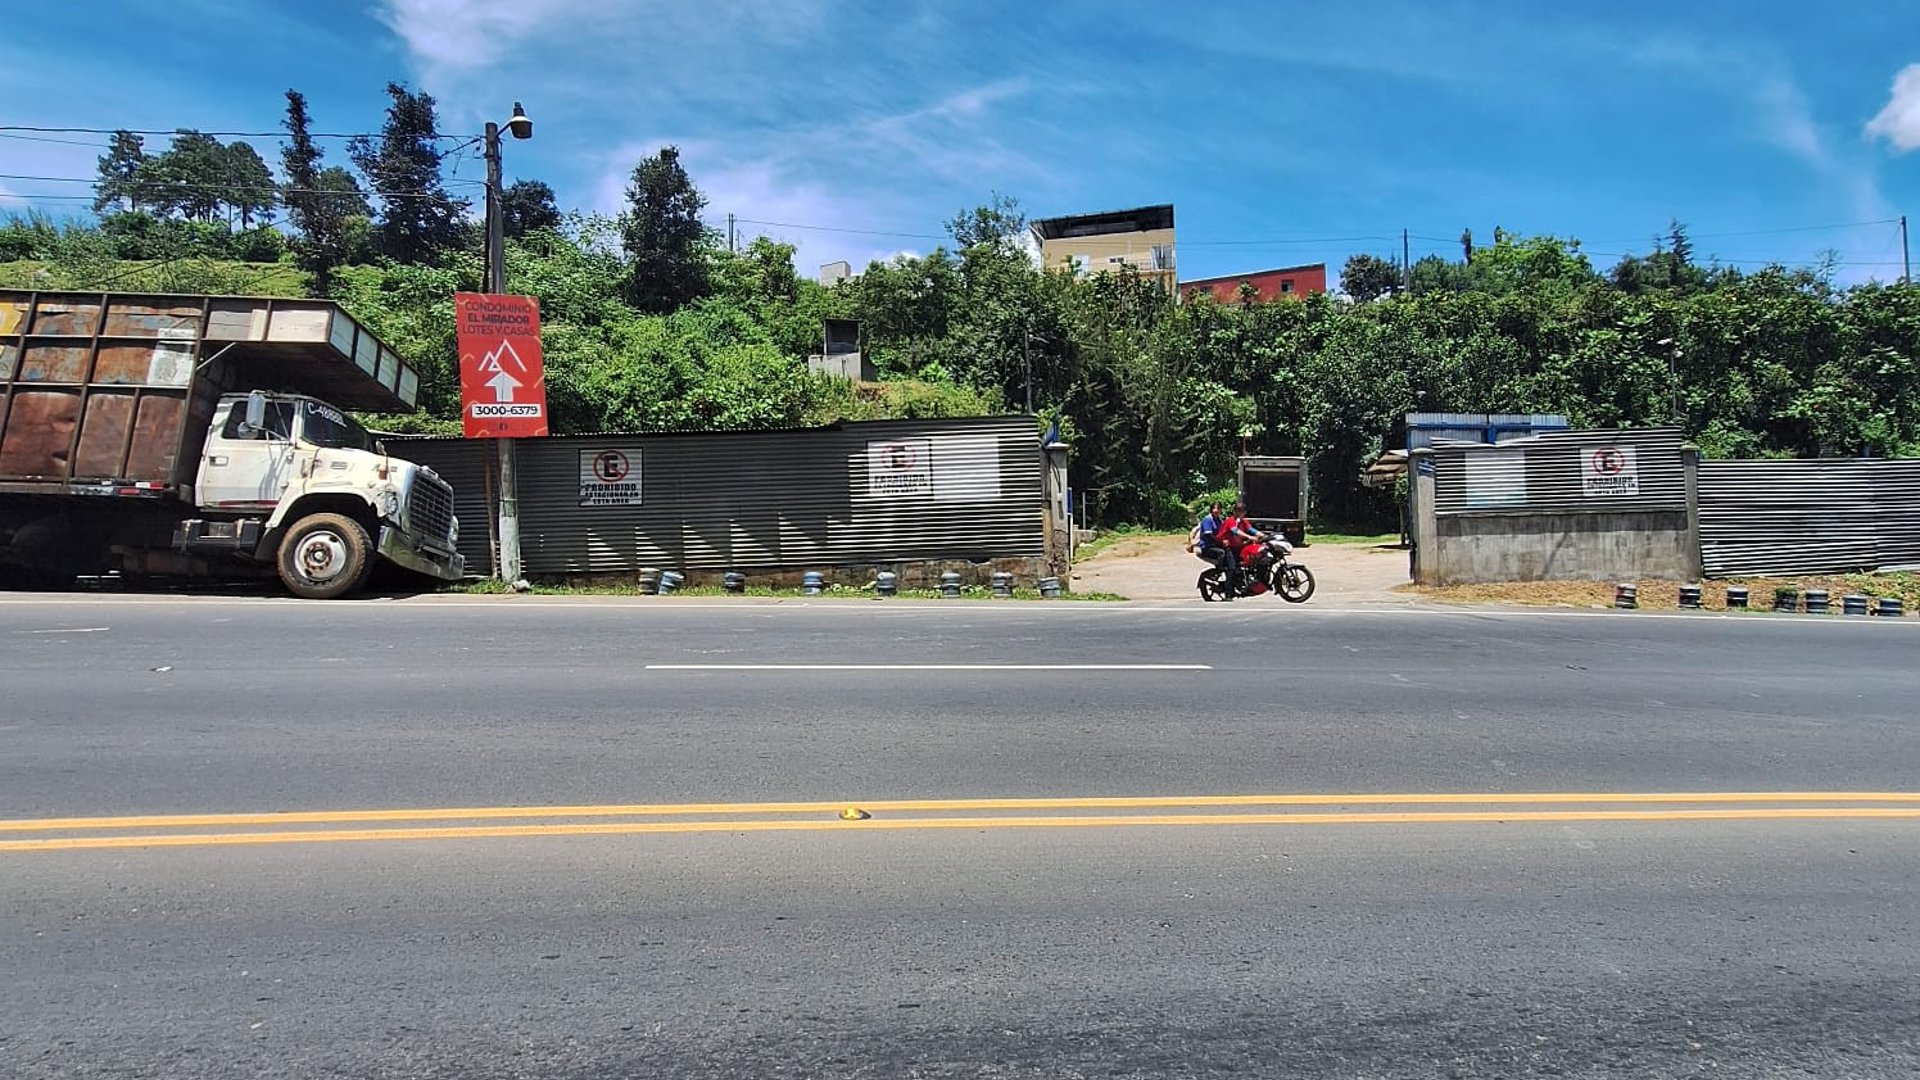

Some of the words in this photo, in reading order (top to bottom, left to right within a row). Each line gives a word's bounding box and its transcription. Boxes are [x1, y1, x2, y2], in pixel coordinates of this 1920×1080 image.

[465, 302, 531, 314] CONDOMINIO
[467, 313, 480, 323] EL
[483, 314, 530, 325] MIRADOR
[463, 324, 494, 335] LOTES
[503, 326, 535, 337] CASAS
[475, 406, 538, 415] 3000-6379
[604, 455, 619, 477] E
[585, 483, 636, 491] PROHIBIDO
